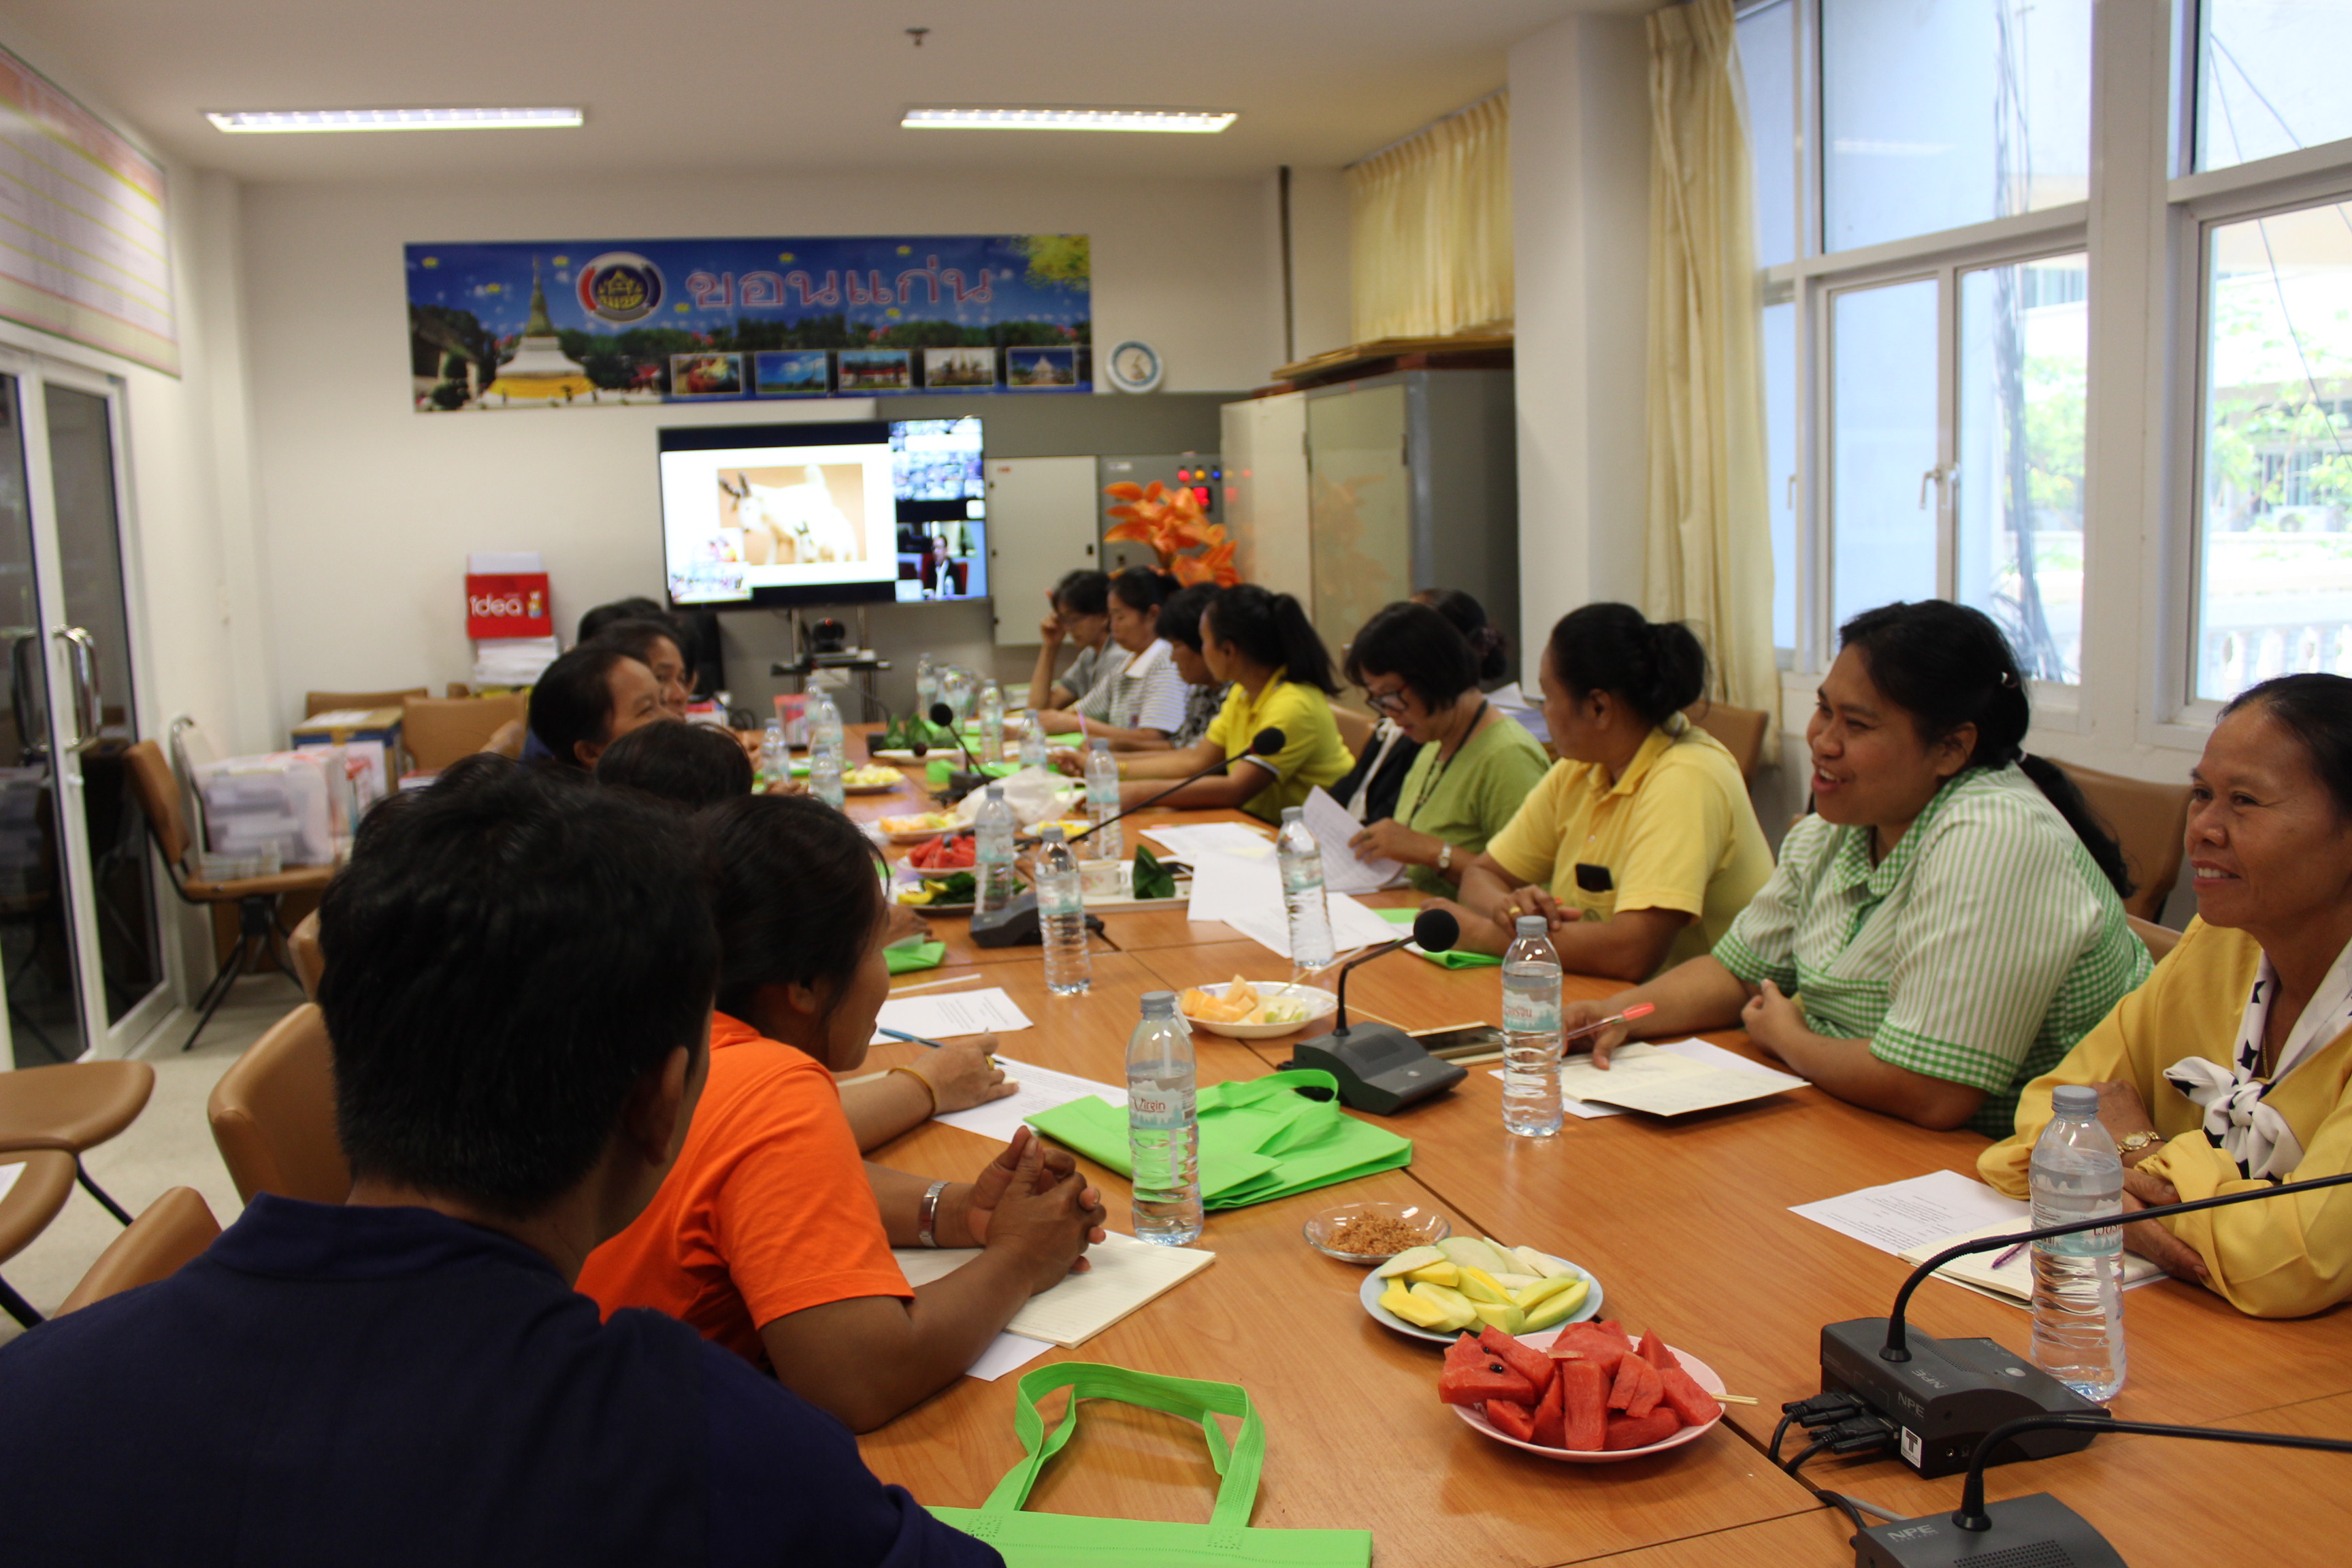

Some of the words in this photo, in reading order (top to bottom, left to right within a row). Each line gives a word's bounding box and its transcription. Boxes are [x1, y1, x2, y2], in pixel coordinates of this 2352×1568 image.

[685, 254, 995, 308] ขอนแก่น
[469, 592, 523, 617] idea
[1132, 1096, 1166, 1113] Virgin
[1898, 1392, 1925, 1419] NPE
[1886, 1524, 1938, 1540] NPE
